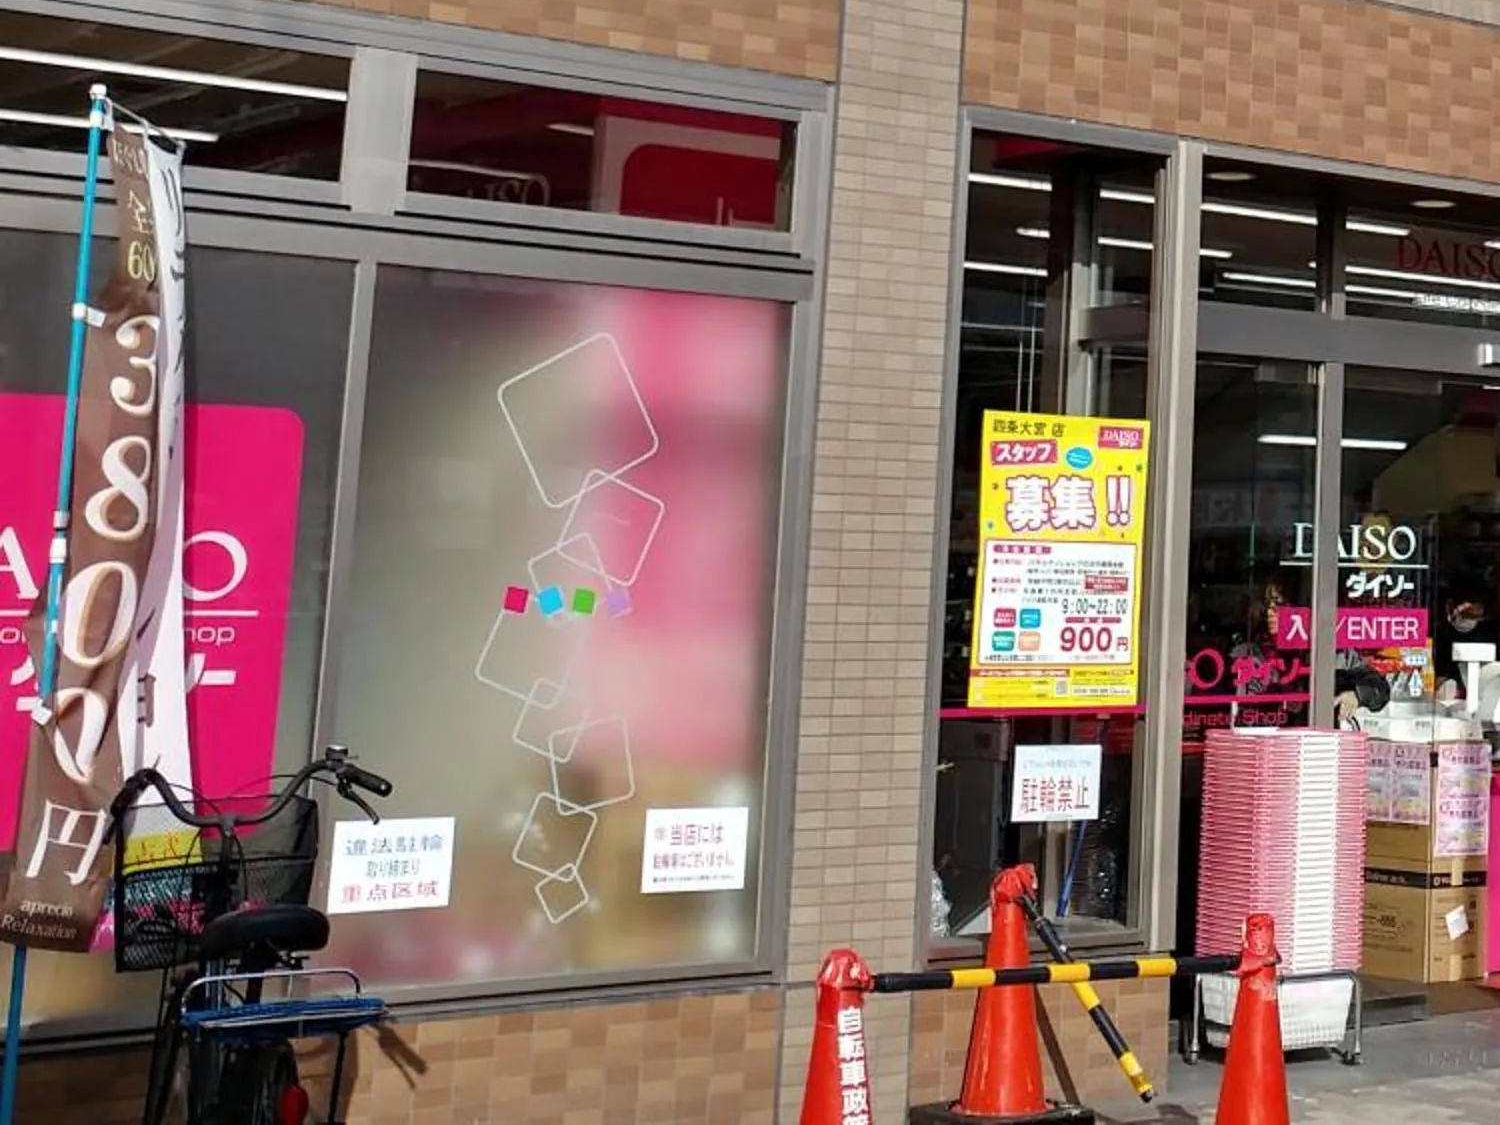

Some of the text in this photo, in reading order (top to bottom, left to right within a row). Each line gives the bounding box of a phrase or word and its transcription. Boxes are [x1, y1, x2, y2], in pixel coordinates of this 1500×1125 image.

[1052, 422, 1065, 438] 店
[1102, 427, 1141, 441] DAISO
[996, 442, 1052, 463] スタッフ
[1293, 522, 1417, 561] DISO
[1345, 572, 1415, 599] ダイソー
[1286, 614, 1420, 641] 入/ENTER
[1020, 775, 1091, 813] 駐輪禁止
[346, 834, 444, 857] 違法駐輪
[342, 880, 441, 904] 重点区域
[20, 899, 74, 918] aprecio
